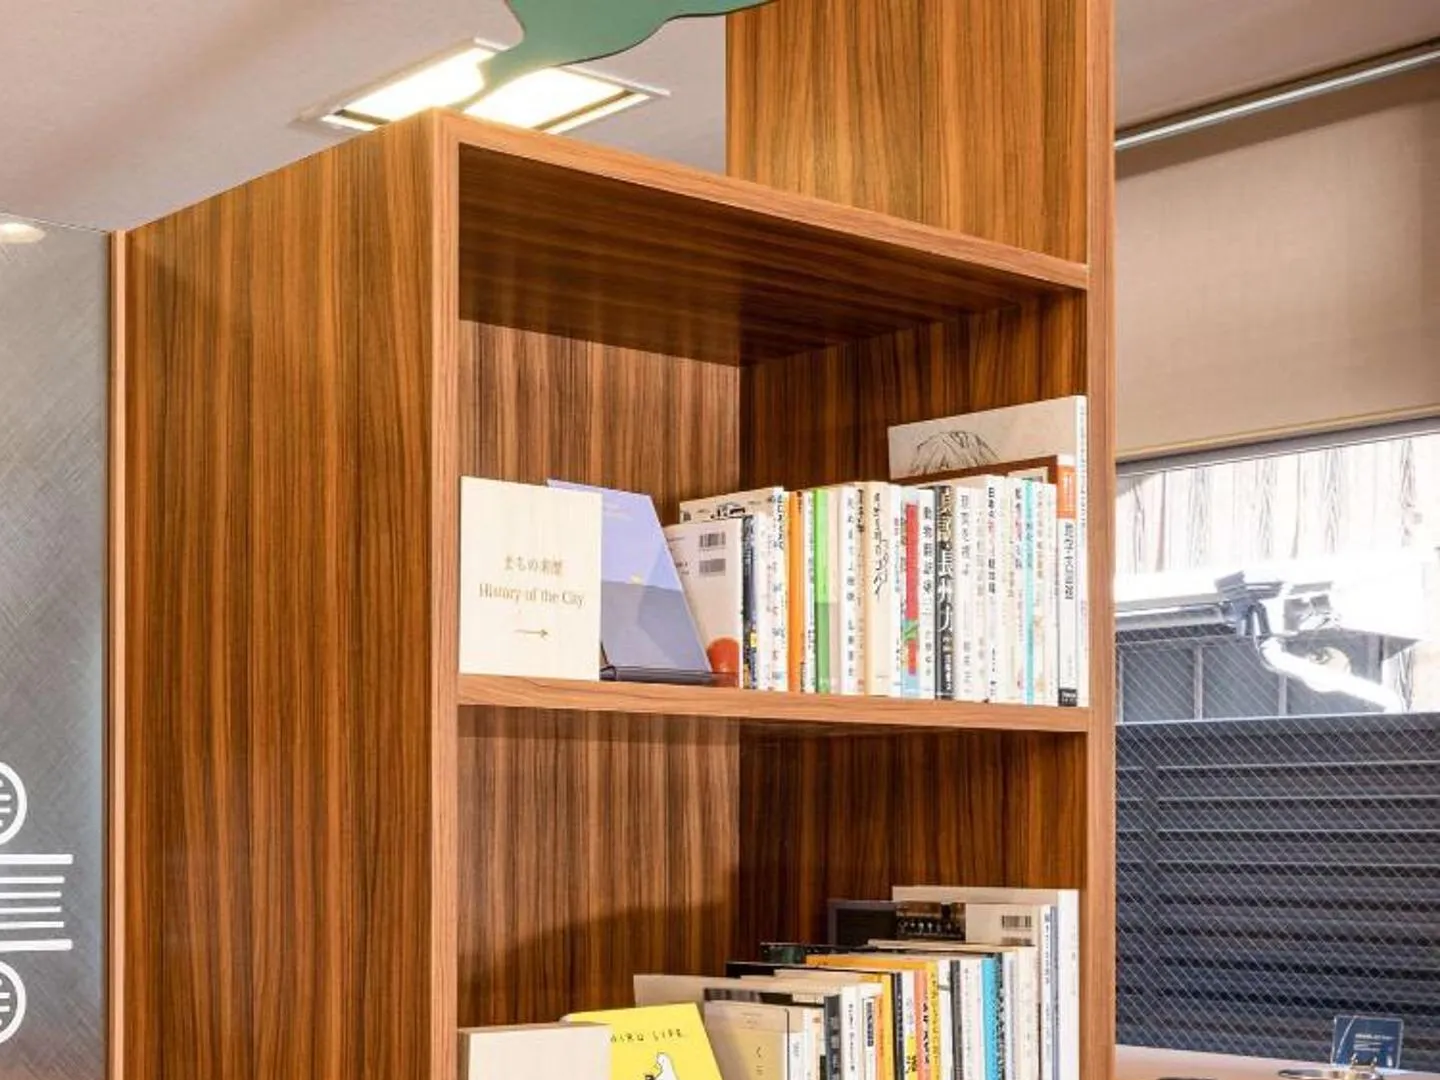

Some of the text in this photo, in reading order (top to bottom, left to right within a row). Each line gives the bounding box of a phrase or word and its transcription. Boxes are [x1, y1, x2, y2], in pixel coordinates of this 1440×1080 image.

[478, 582, 586, 609] History of the City
